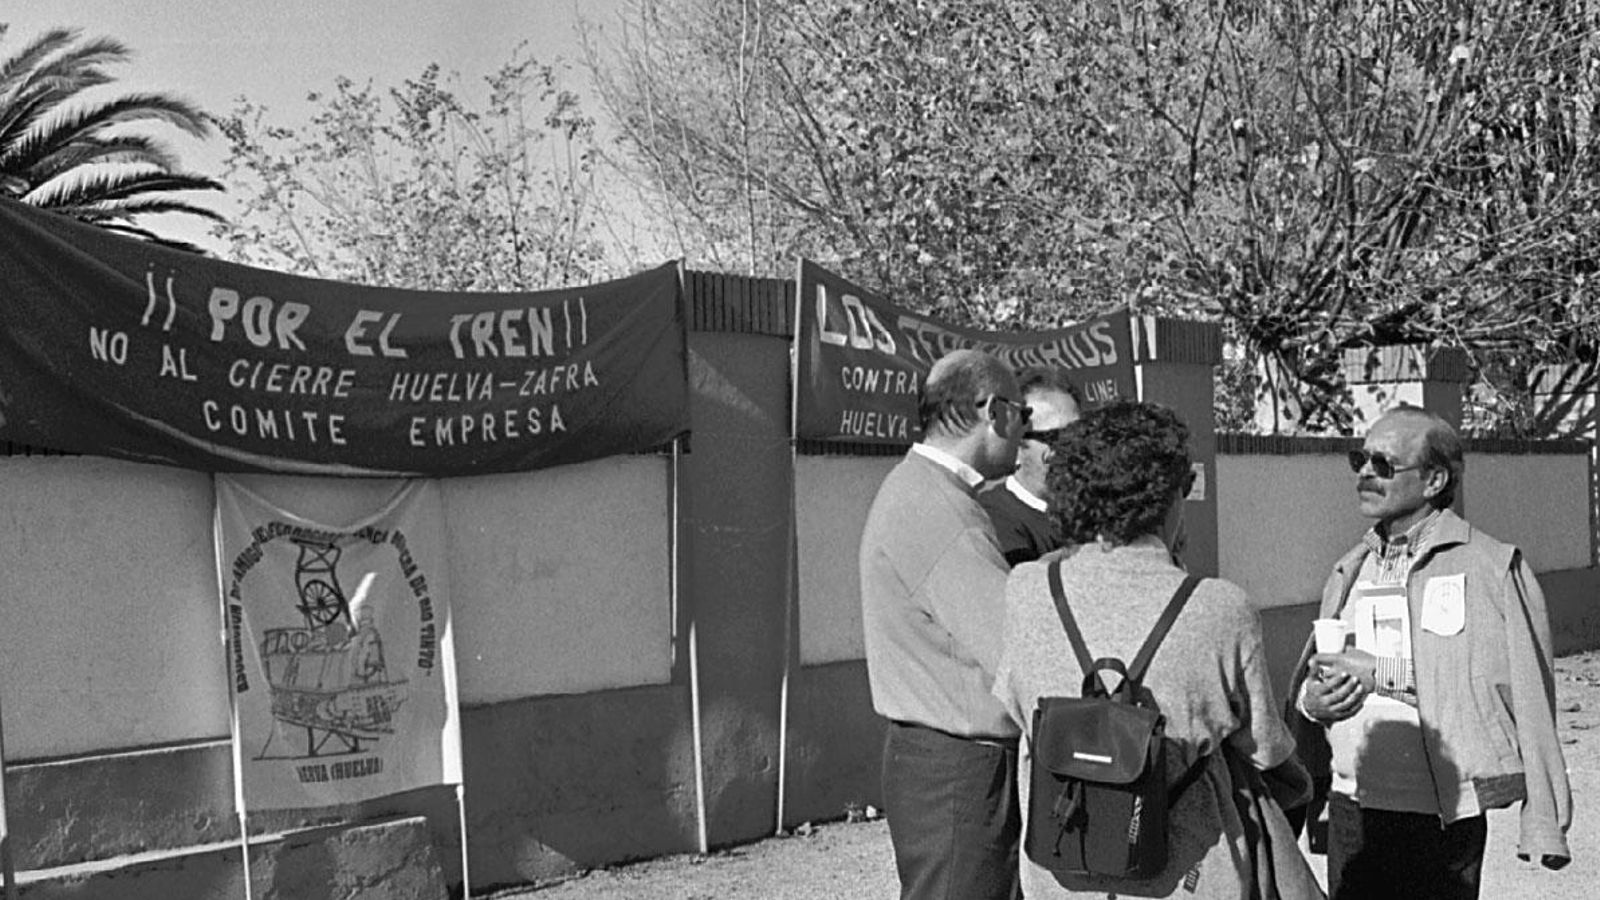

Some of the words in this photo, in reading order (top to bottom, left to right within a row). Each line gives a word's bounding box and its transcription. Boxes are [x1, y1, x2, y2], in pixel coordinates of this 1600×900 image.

[208, 287, 310, 350] POR
[345, 309, 409, 358] EL
[816, 284, 896, 355] LOS
[90, 326, 128, 365] NO
[160, 345, 198, 381] AL
[229, 359, 356, 397] CIERRE
[389, 361, 599, 401] HUELVA-ZAFRA
[841, 366, 919, 395] CONTRA
[203, 400, 347, 445] COMITE
[409, 404, 568, 446] EMPRESA
